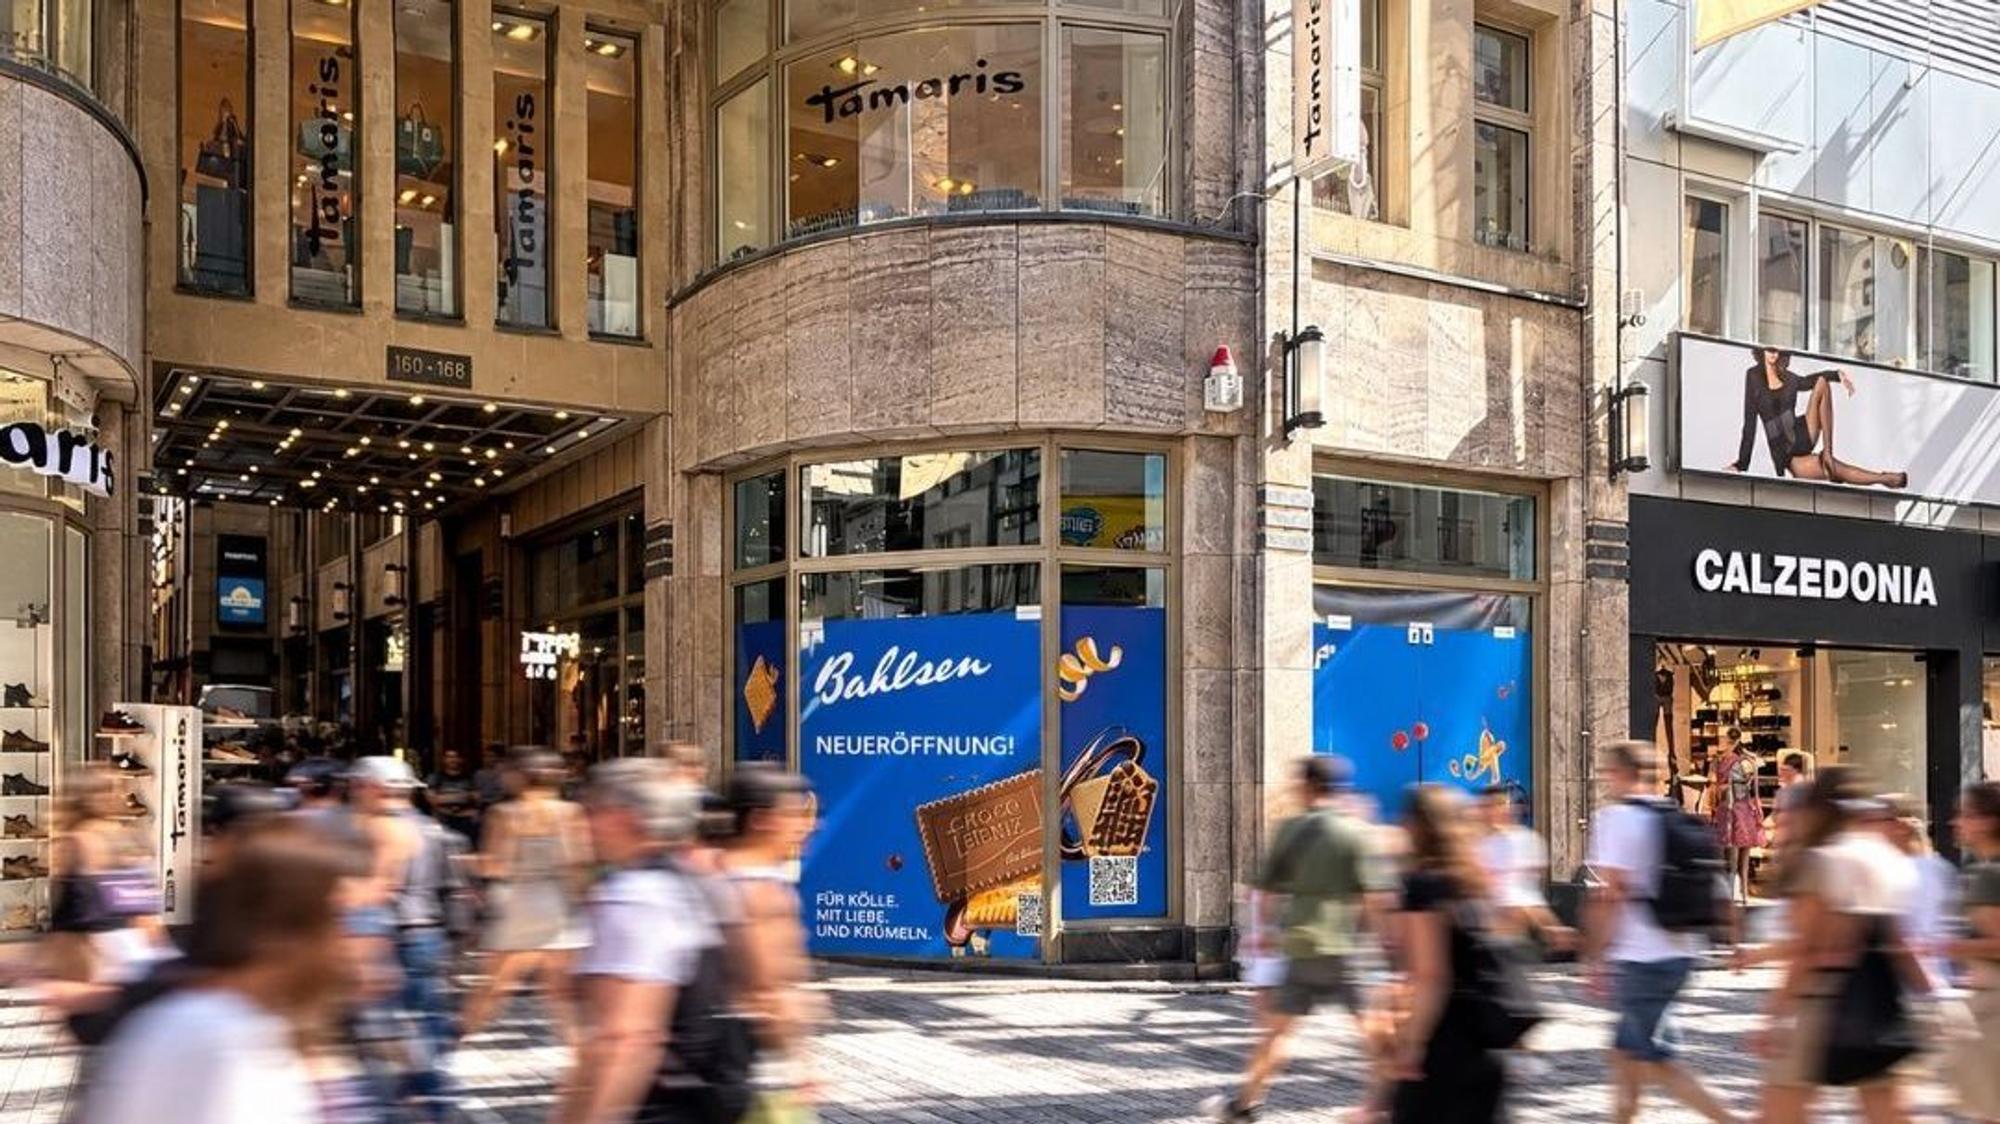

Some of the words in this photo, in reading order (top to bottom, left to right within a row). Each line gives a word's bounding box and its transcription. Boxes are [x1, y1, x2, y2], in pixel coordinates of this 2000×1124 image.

[1695, 548, 1938, 606] CALZEDONIA
[814, 645, 992, 704] Bahlsen
[816, 731, 1015, 755] NEUERÖFFNUNG!
[949, 799, 1020, 833] CROCO
[816, 890, 844, 907] FÜR
[848, 891, 899, 908] KÖLLE.
[816, 908, 842, 921] MIT
[846, 909, 889, 924] LIEBE.
[816, 924, 850, 938] UND
[854, 923, 932, 940] KRÜMELN.
